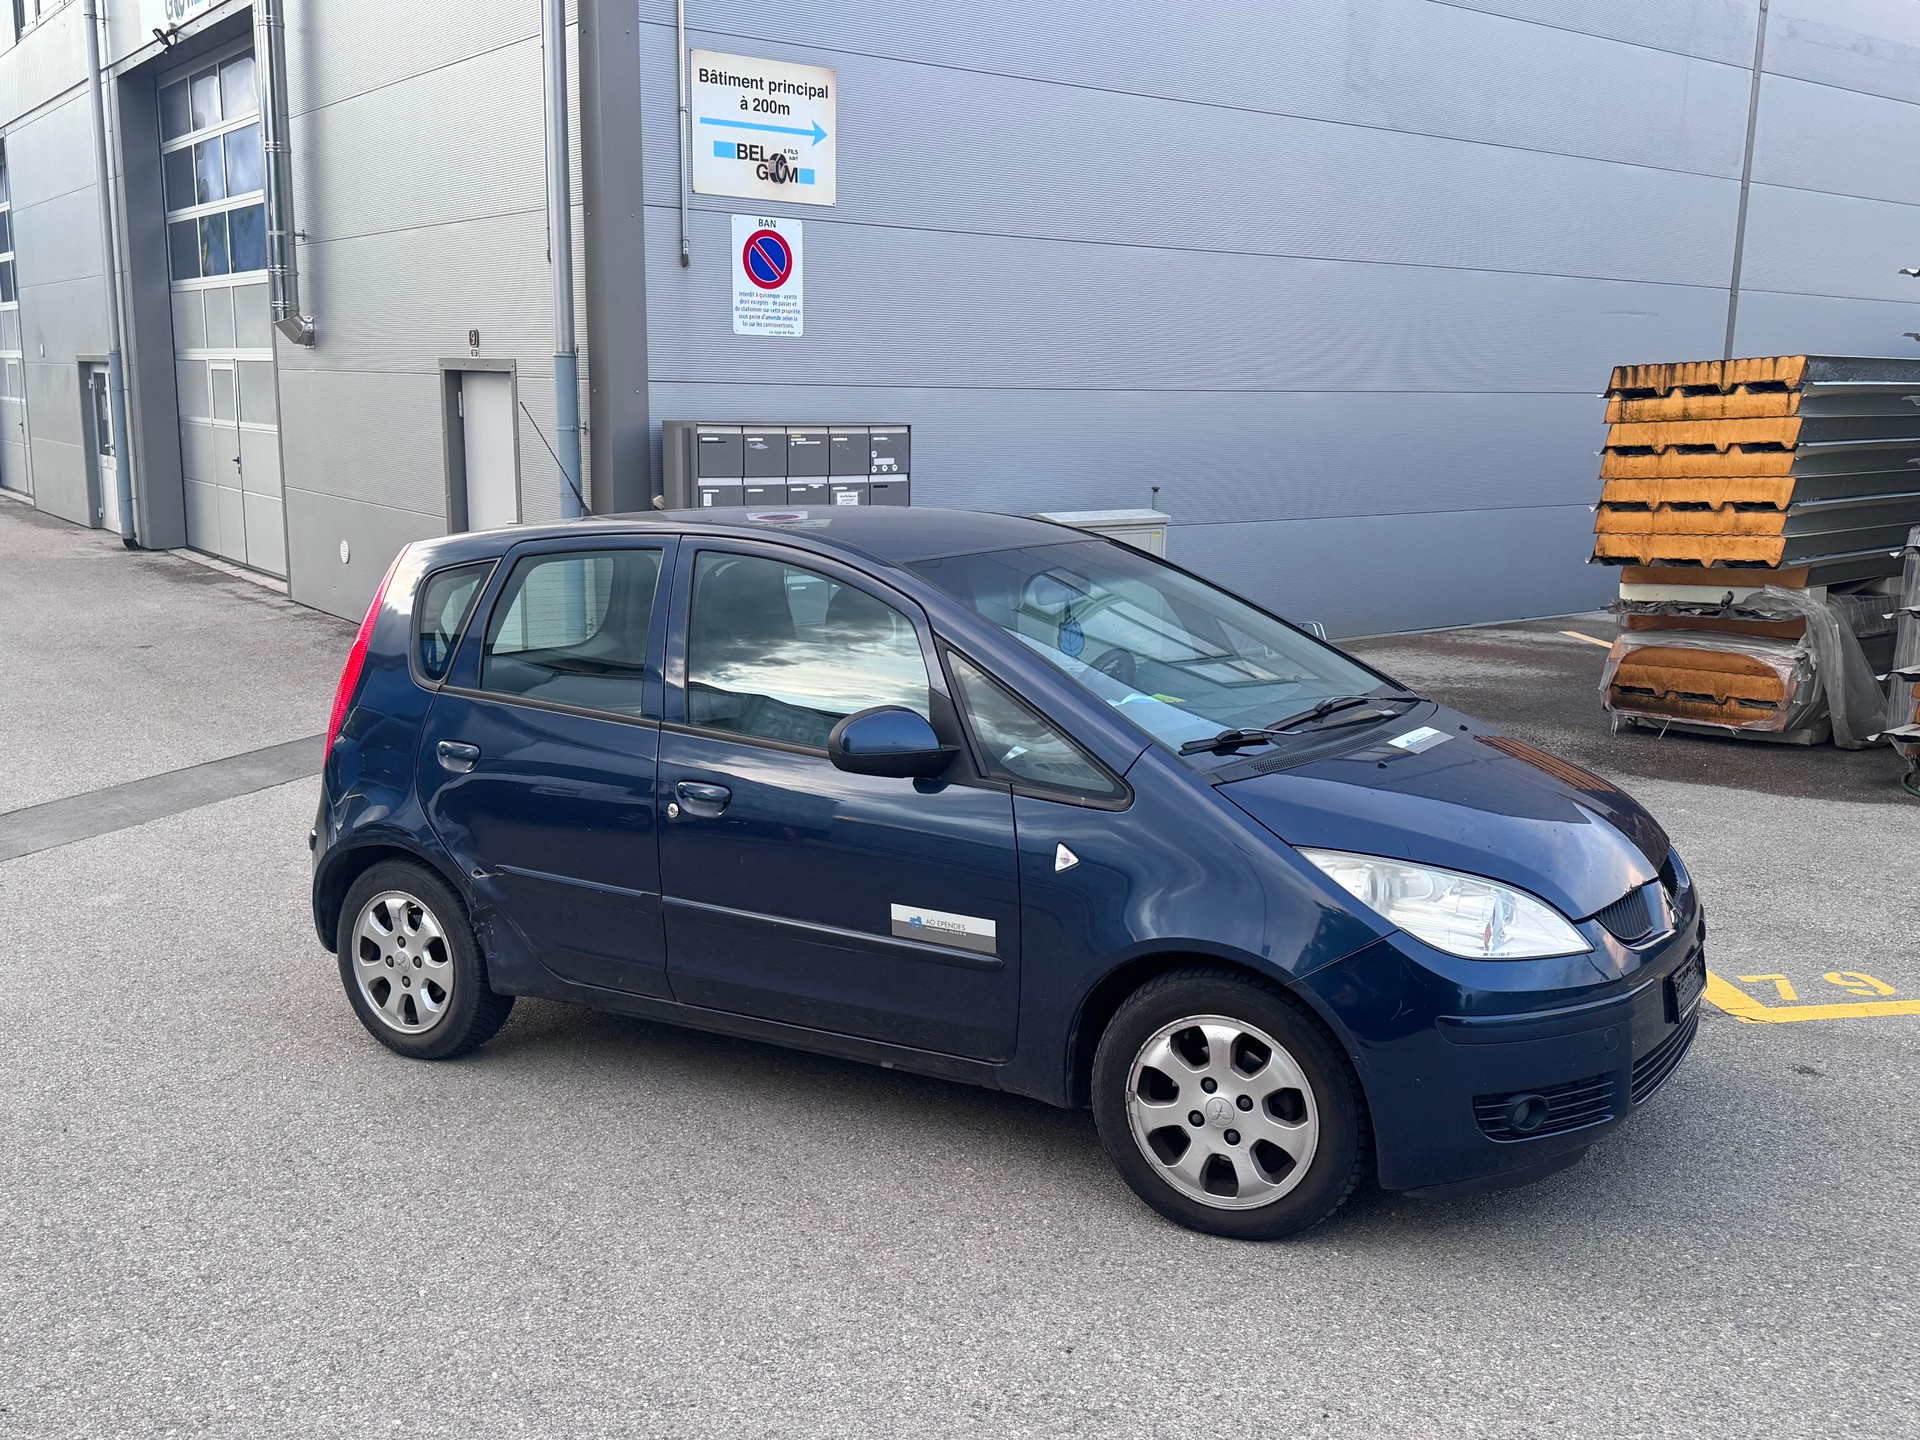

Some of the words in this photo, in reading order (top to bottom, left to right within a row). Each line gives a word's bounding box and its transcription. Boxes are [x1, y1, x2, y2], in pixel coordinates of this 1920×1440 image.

[699, 68, 764, 91] Bâtiment
[768, 79, 829, 100] principal
[740, 95, 748, 111] à
[752, 98, 791, 116] 200m
[736, 143, 768, 162] BEL
[758, 218, 777, 228] BAN
[937, 920, 966, 931] EPENDES
